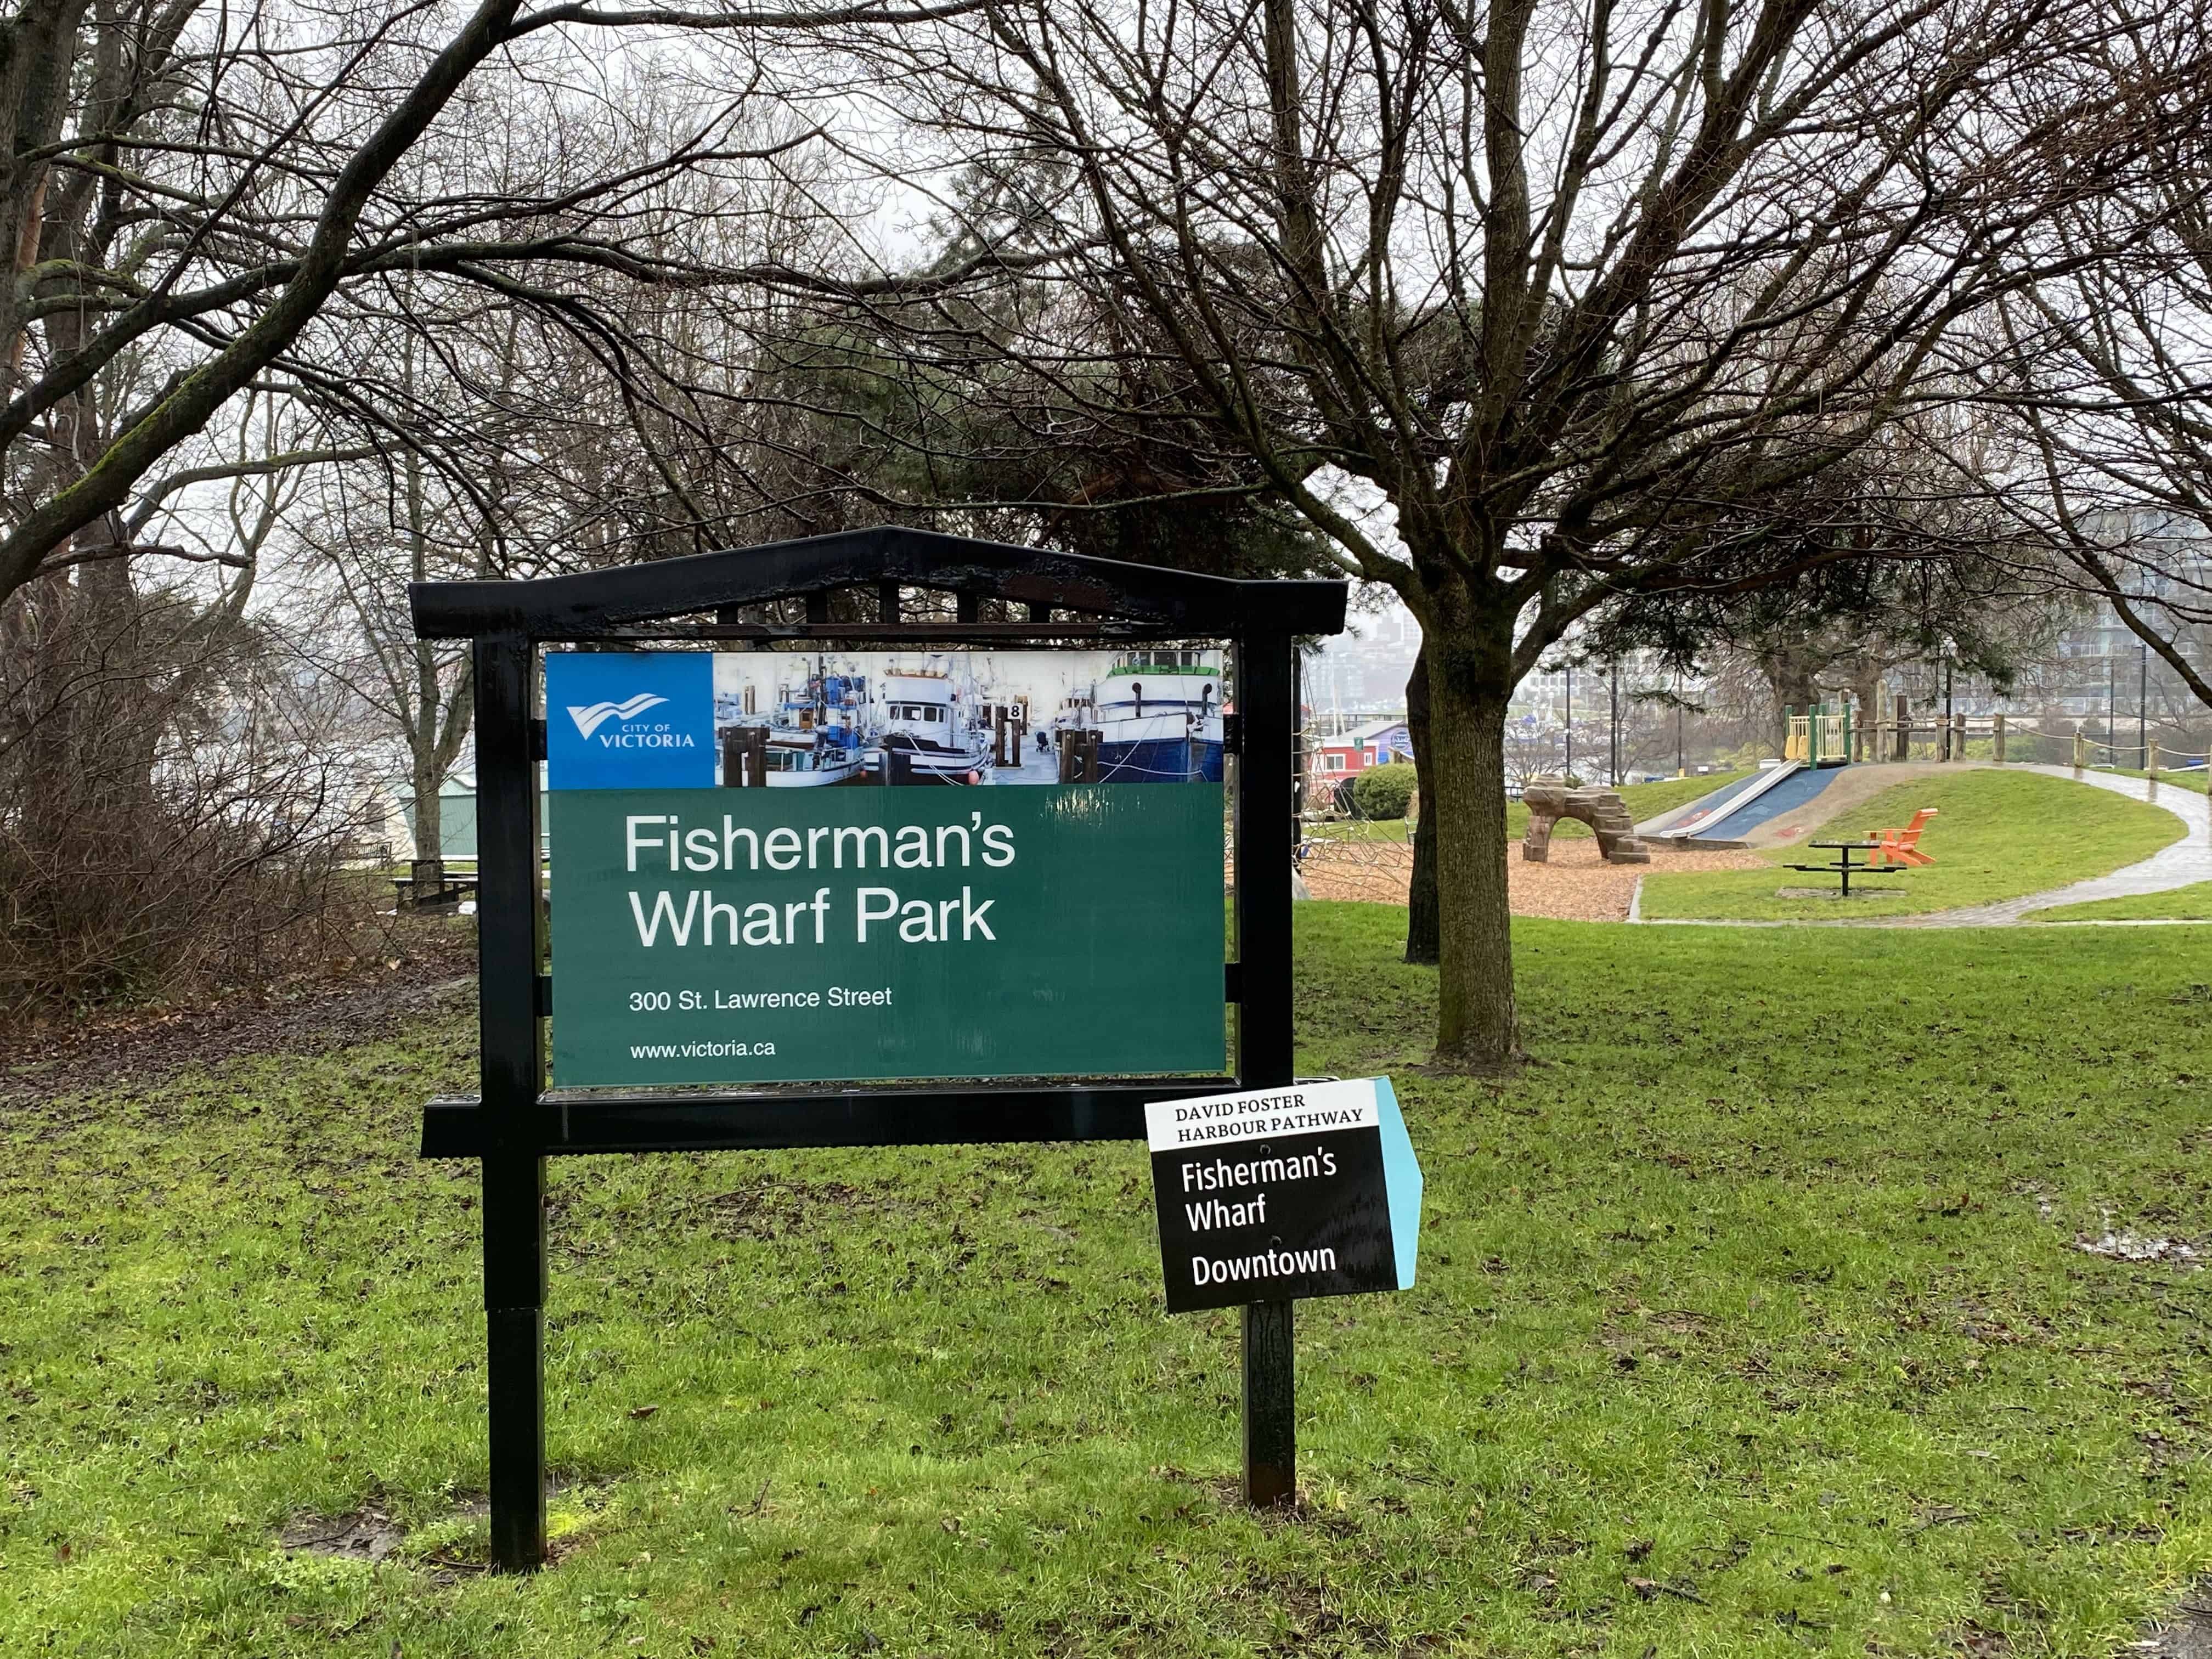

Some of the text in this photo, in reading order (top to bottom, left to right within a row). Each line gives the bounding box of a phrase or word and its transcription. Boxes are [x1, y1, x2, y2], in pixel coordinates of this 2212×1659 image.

[1011, 706, 1019, 717] 8
[600, 734, 695, 748] VICTORIA
[622, 724, 650, 732] CITY
[627, 812, 1015, 871] Fisherman's
[629, 886, 996, 946] Wharf Park
[629, 987, 892, 1011] 300 St. Lawrence Street
[630, 1040, 776, 1058] www.victoria.ca
[1175, 1094, 1305, 1122] DAVID FOSTER
[1178, 1108, 1364, 1142] HARBOUR PATHWAY
[1181, 1147, 1337, 1192] Fisherman's
[1185, 1193, 1266, 1232] Wharf
[1192, 1247, 1336, 1286] Downtown
